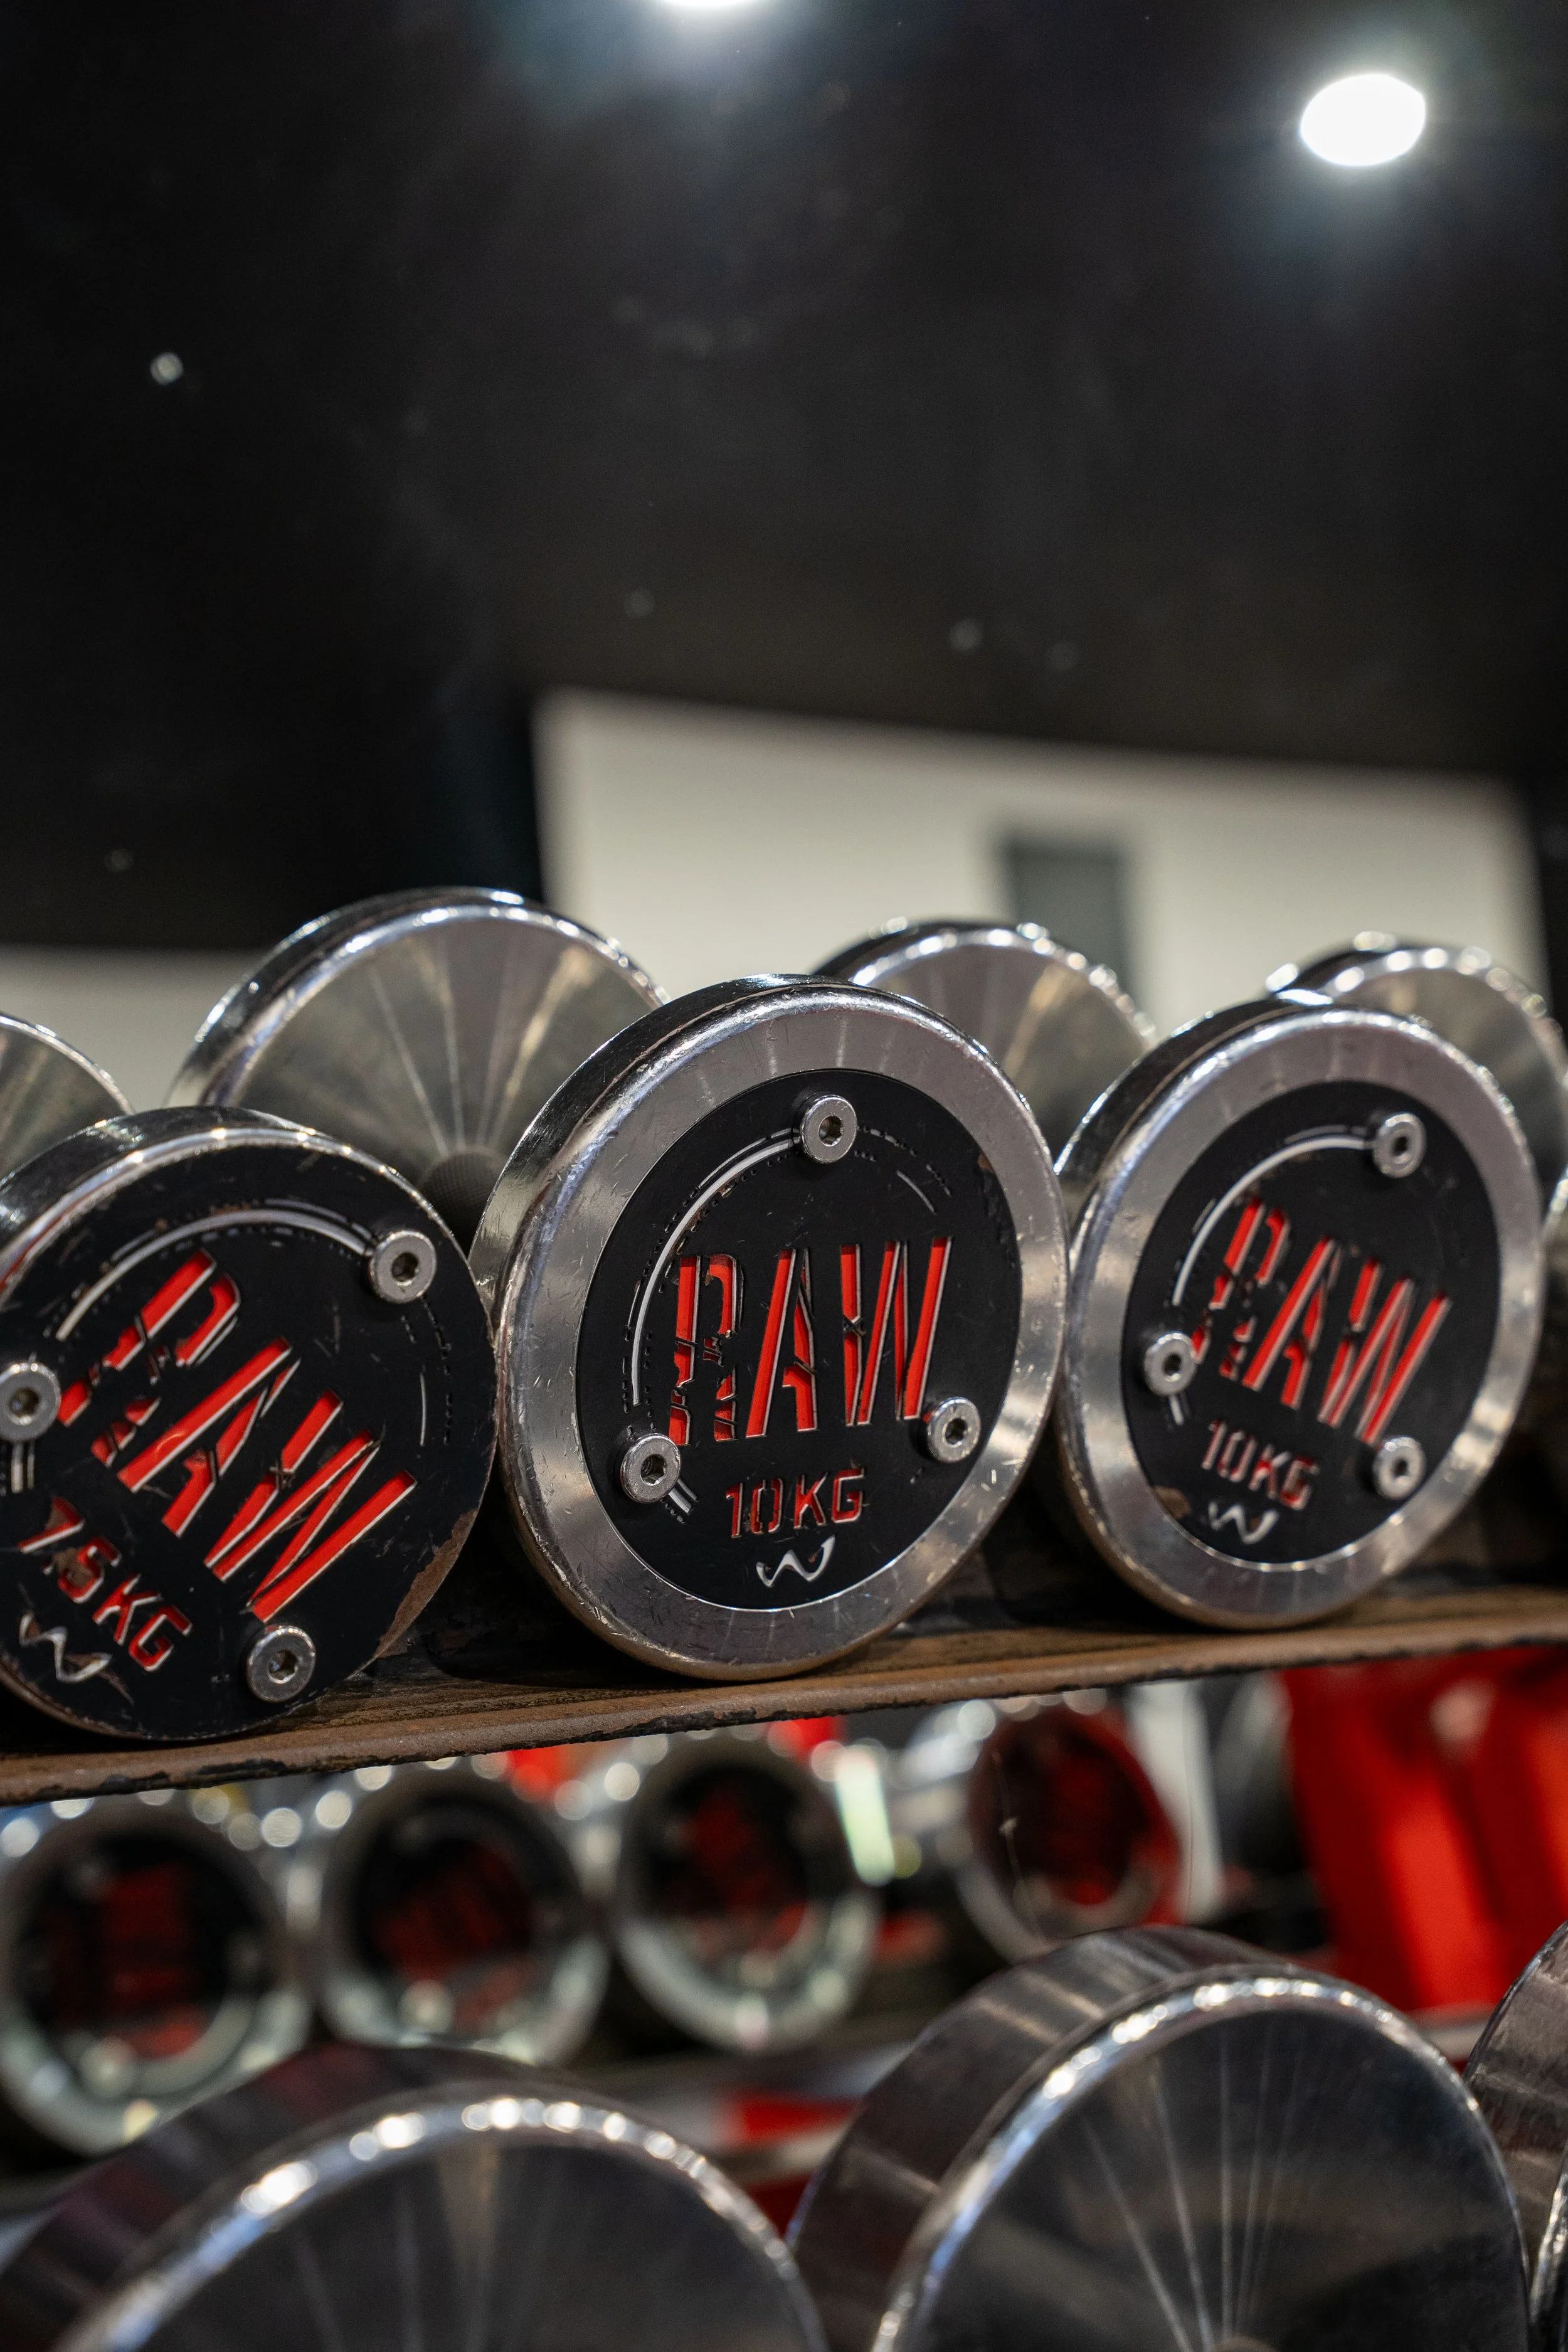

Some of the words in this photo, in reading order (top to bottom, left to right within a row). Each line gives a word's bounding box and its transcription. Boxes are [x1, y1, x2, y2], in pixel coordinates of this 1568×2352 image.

[668, 1239, 952, 1446] RAW
[1191, 1199, 1451, 1444] RAW
[58, 1249, 418, 1623] RAW
[725, 1468, 866, 1538] 10KG
[1202, 1420, 1318, 1509] 10KG
